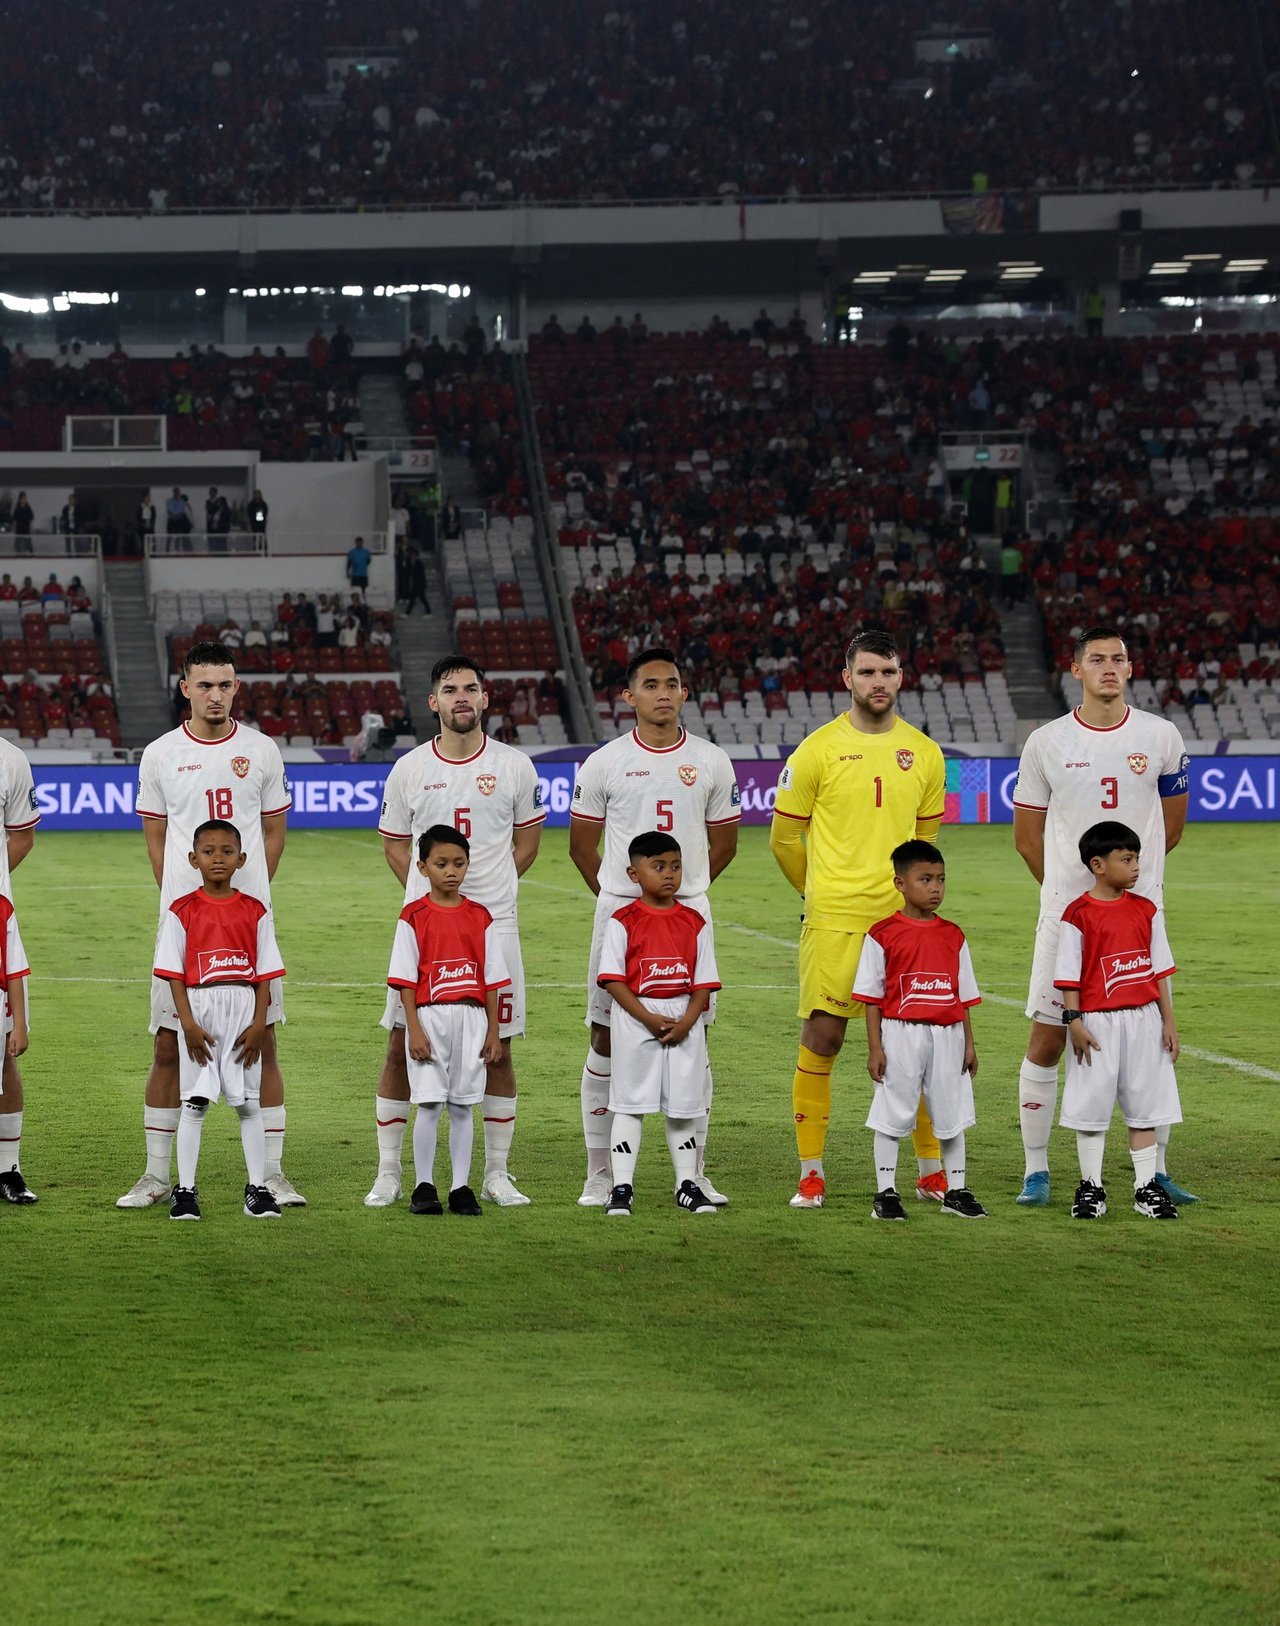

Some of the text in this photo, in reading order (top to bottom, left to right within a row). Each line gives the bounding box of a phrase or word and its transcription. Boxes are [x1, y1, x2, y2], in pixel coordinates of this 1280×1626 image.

[177, 763, 202, 772] erspo
[839, 753, 863, 761] erspo
[1065, 760, 1090, 769] erspo
[423, 782, 447, 791] erspo
[625, 769, 650, 777] erspo
[34, 782, 133, 814] SIAN
[205, 787, 233, 821] 18
[874, 776, 882, 808] 1
[1100, 776, 1119, 809] 3
[454, 807, 472, 839] 6
[656, 800, 673, 832] 5
[497, 993, 514, 1024] 6
[826, 995, 849, 1008] erspo
